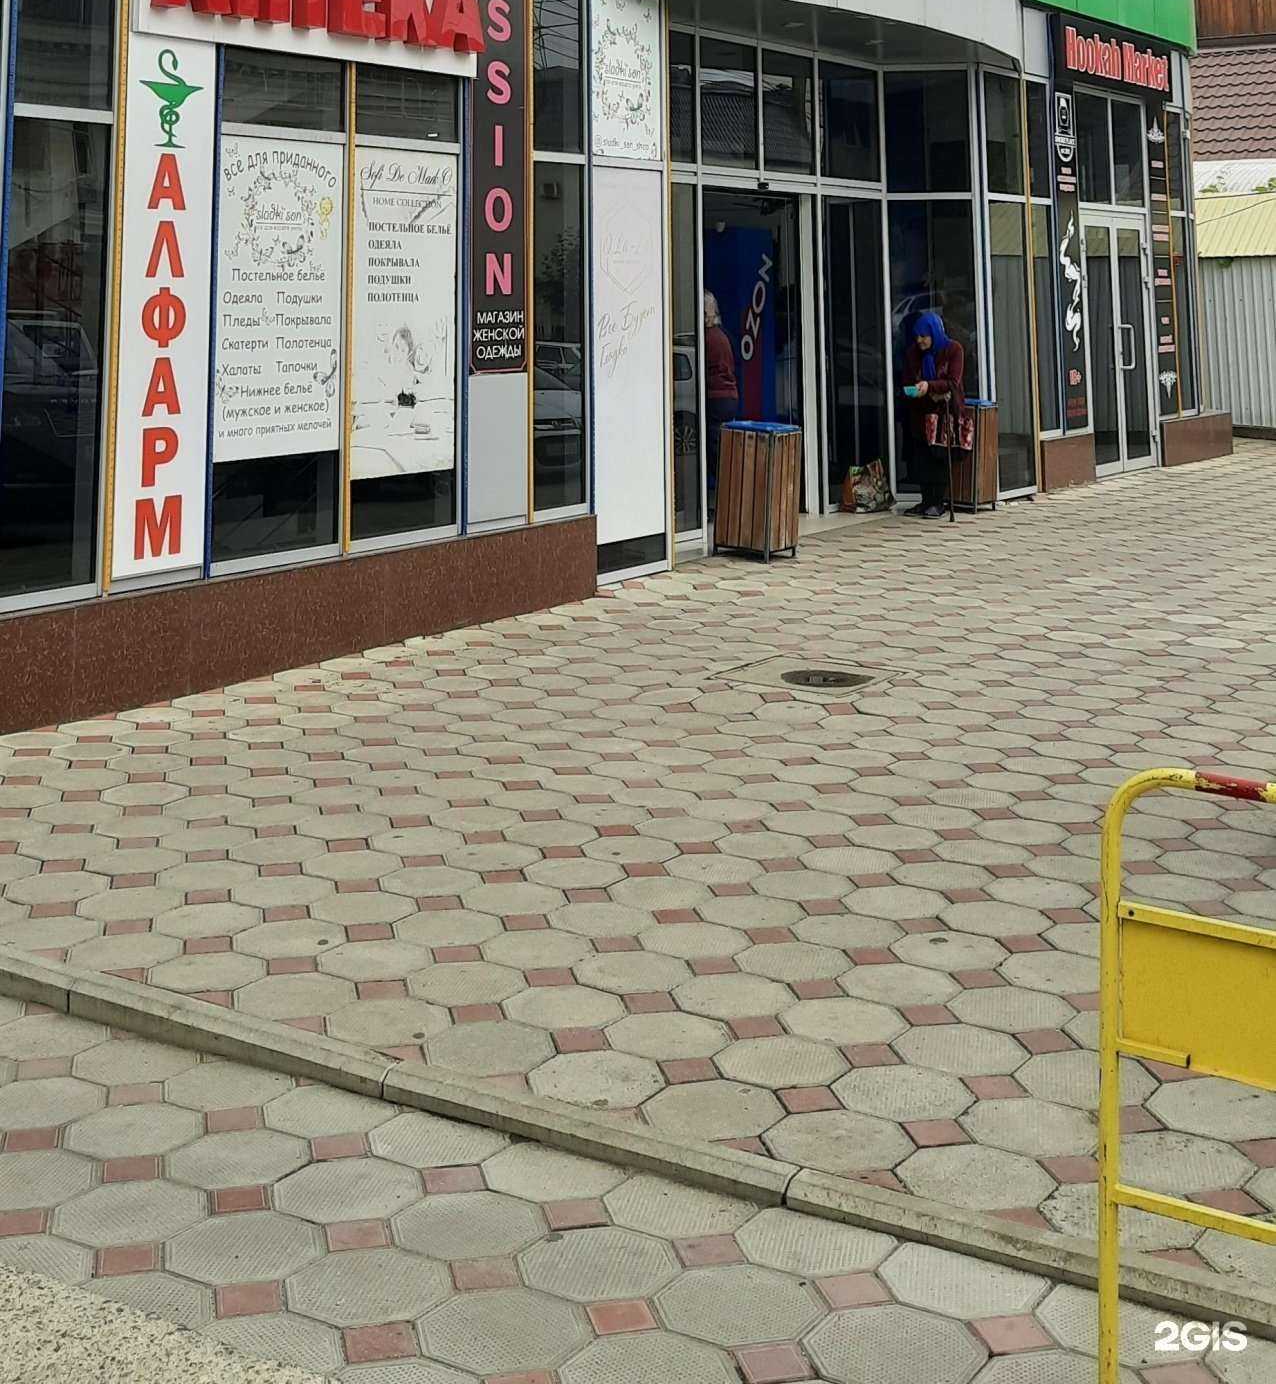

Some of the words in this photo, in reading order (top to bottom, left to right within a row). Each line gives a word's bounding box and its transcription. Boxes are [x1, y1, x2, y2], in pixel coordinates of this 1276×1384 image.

[1065, 25, 1122, 81] Hookah
[1122, 41, 1170, 93] Market
[247, 151, 269, 171] для
[272, 150, 337, 189] приданного
[385, 162, 404, 184] De
[372, 196, 396, 207] HOME
[396, 197, 442, 209] COLLECTION
[285, 209, 302, 221] son
[368, 221, 425, 234] ПОСТЕЛЬНОЕ
[368, 239, 402, 250] ОДЕЯЛА
[368, 257, 420, 268] ПОКРЫВАЛА
[231, 268, 293, 282] Постельное
[367, 274, 411, 285] ПОДУШКИ
[223, 291, 263, 305] Одеяла
[276, 291, 323, 307] Подушки
[367, 292, 420, 304] ПОЛОТЕНЦА
[740, 252, 773, 361] OZON
[222, 314, 261, 327] Пледы
[275, 313, 332, 329] Покрывала
[477, 310, 524, 324] МАГАЗИН
[473, 324, 525, 341] ЖЕНСКОЙ
[222, 338, 269, 352] Скатерти
[276, 336, 332, 350] Полотенца
[133, 151, 187, 561] АЛФАРМ
[476, 344, 522, 361] ОДЕЖДЫ
[222, 363, 262, 376] Халаты
[276, 360, 318, 374] Тапочки
[240, 384, 281, 398] Нижнее
[222, 404, 271, 422] (мужское
[274, 405, 281, 415] и
[284, 398, 330, 415] женское)
[218, 430, 225, 439] и
[226, 427, 254, 439] много
[255, 422, 296, 439] приятных
[297, 417, 332, 432] мелочей
